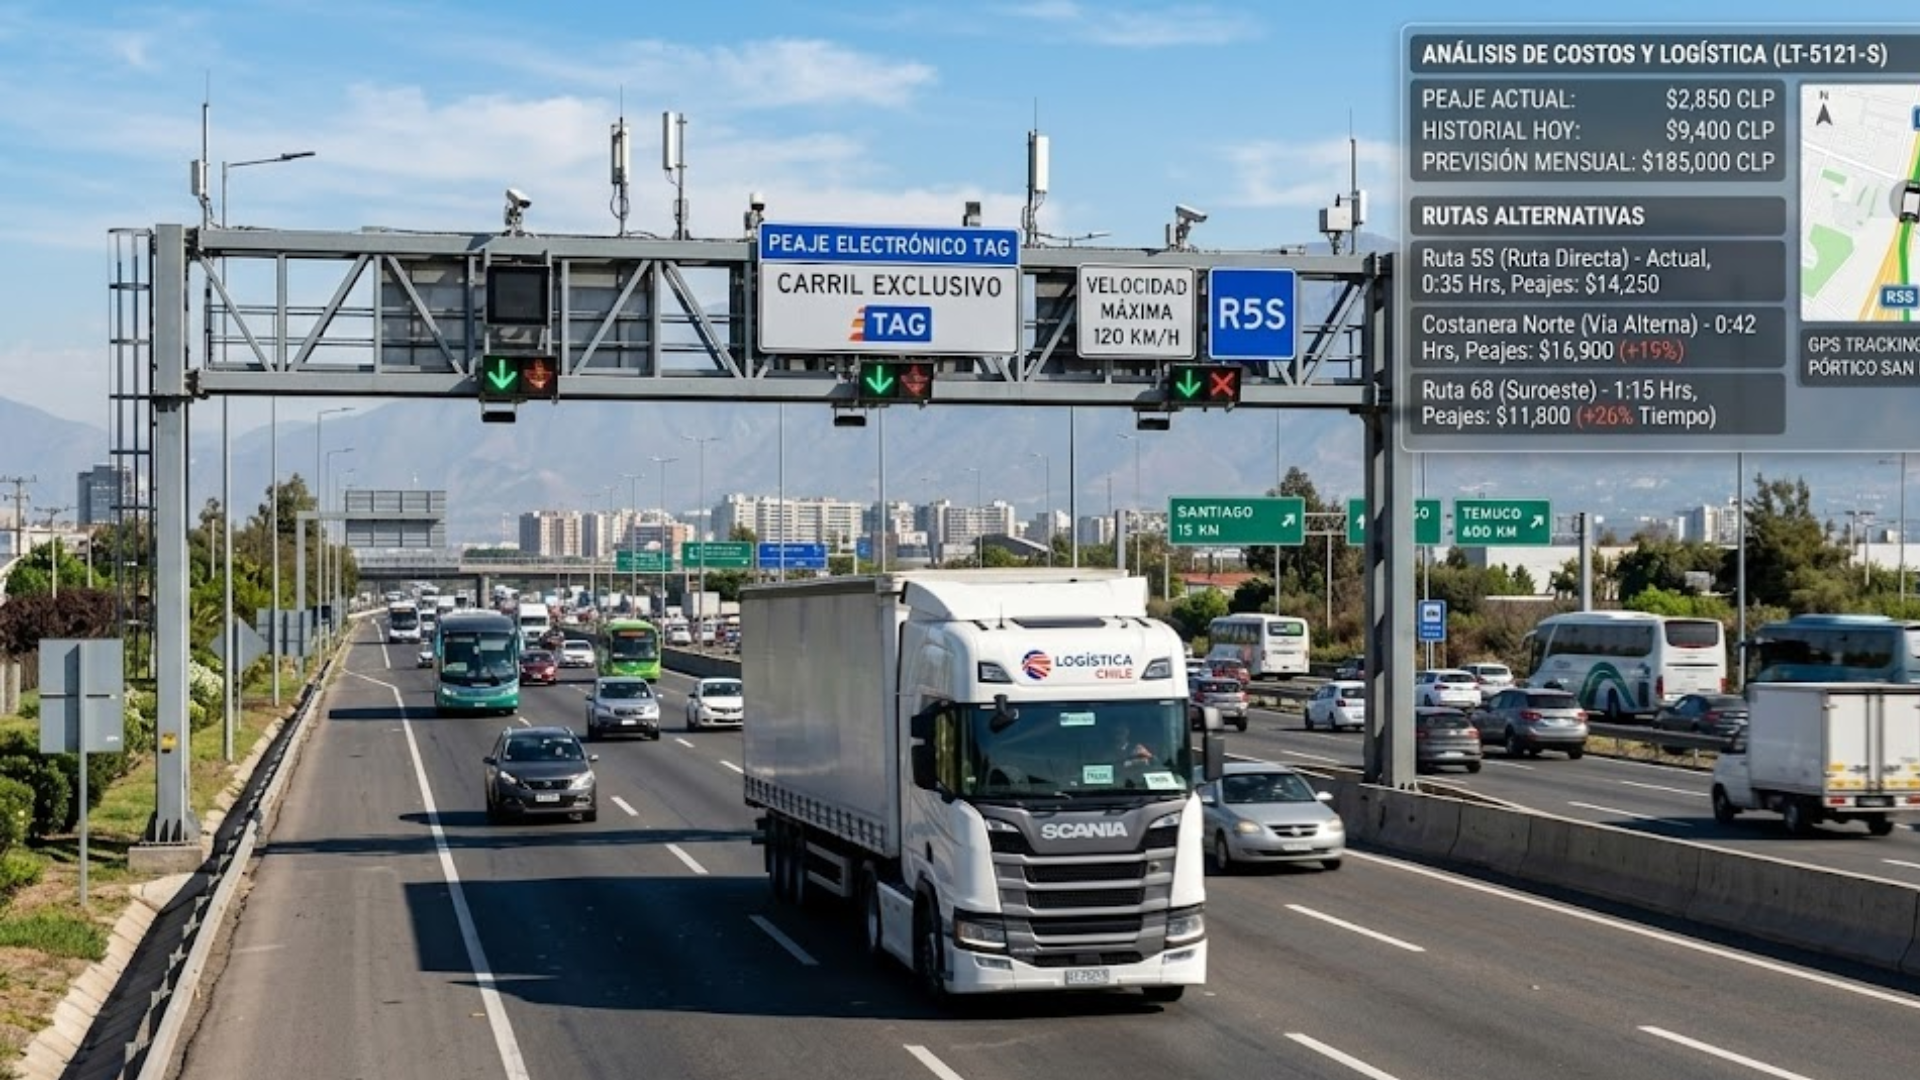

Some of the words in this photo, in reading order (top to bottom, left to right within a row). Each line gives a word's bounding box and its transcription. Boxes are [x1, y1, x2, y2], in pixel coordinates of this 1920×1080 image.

[769, 234, 829, 251] PEAJE
[836, 233, 966, 255] ELECTRÓNICO
[973, 238, 1010, 256] TAG
[777, 273, 863, 295] CARRIL
[873, 274, 1002, 297] EXCLUSIVO
[1086, 277, 1187, 295] VELOCIDAD
[1101, 299, 1173, 320] MÁXIMA
[1220, 298, 1286, 329] R5S
[872, 313, 926, 335] TAG
[1094, 328, 1124, 345] 120
[1130, 329, 1180, 347] KM/H
[1177, 506, 1253, 518] SANTIAGO
[1462, 507, 1522, 520] TEMUCO
[1496, 526, 1516, 538] KM
[1055, 652, 1133, 667] LOGÍSTICA
[1095, 668, 1133, 679] CHILE
[1042, 822, 1128, 839] SCANIA
